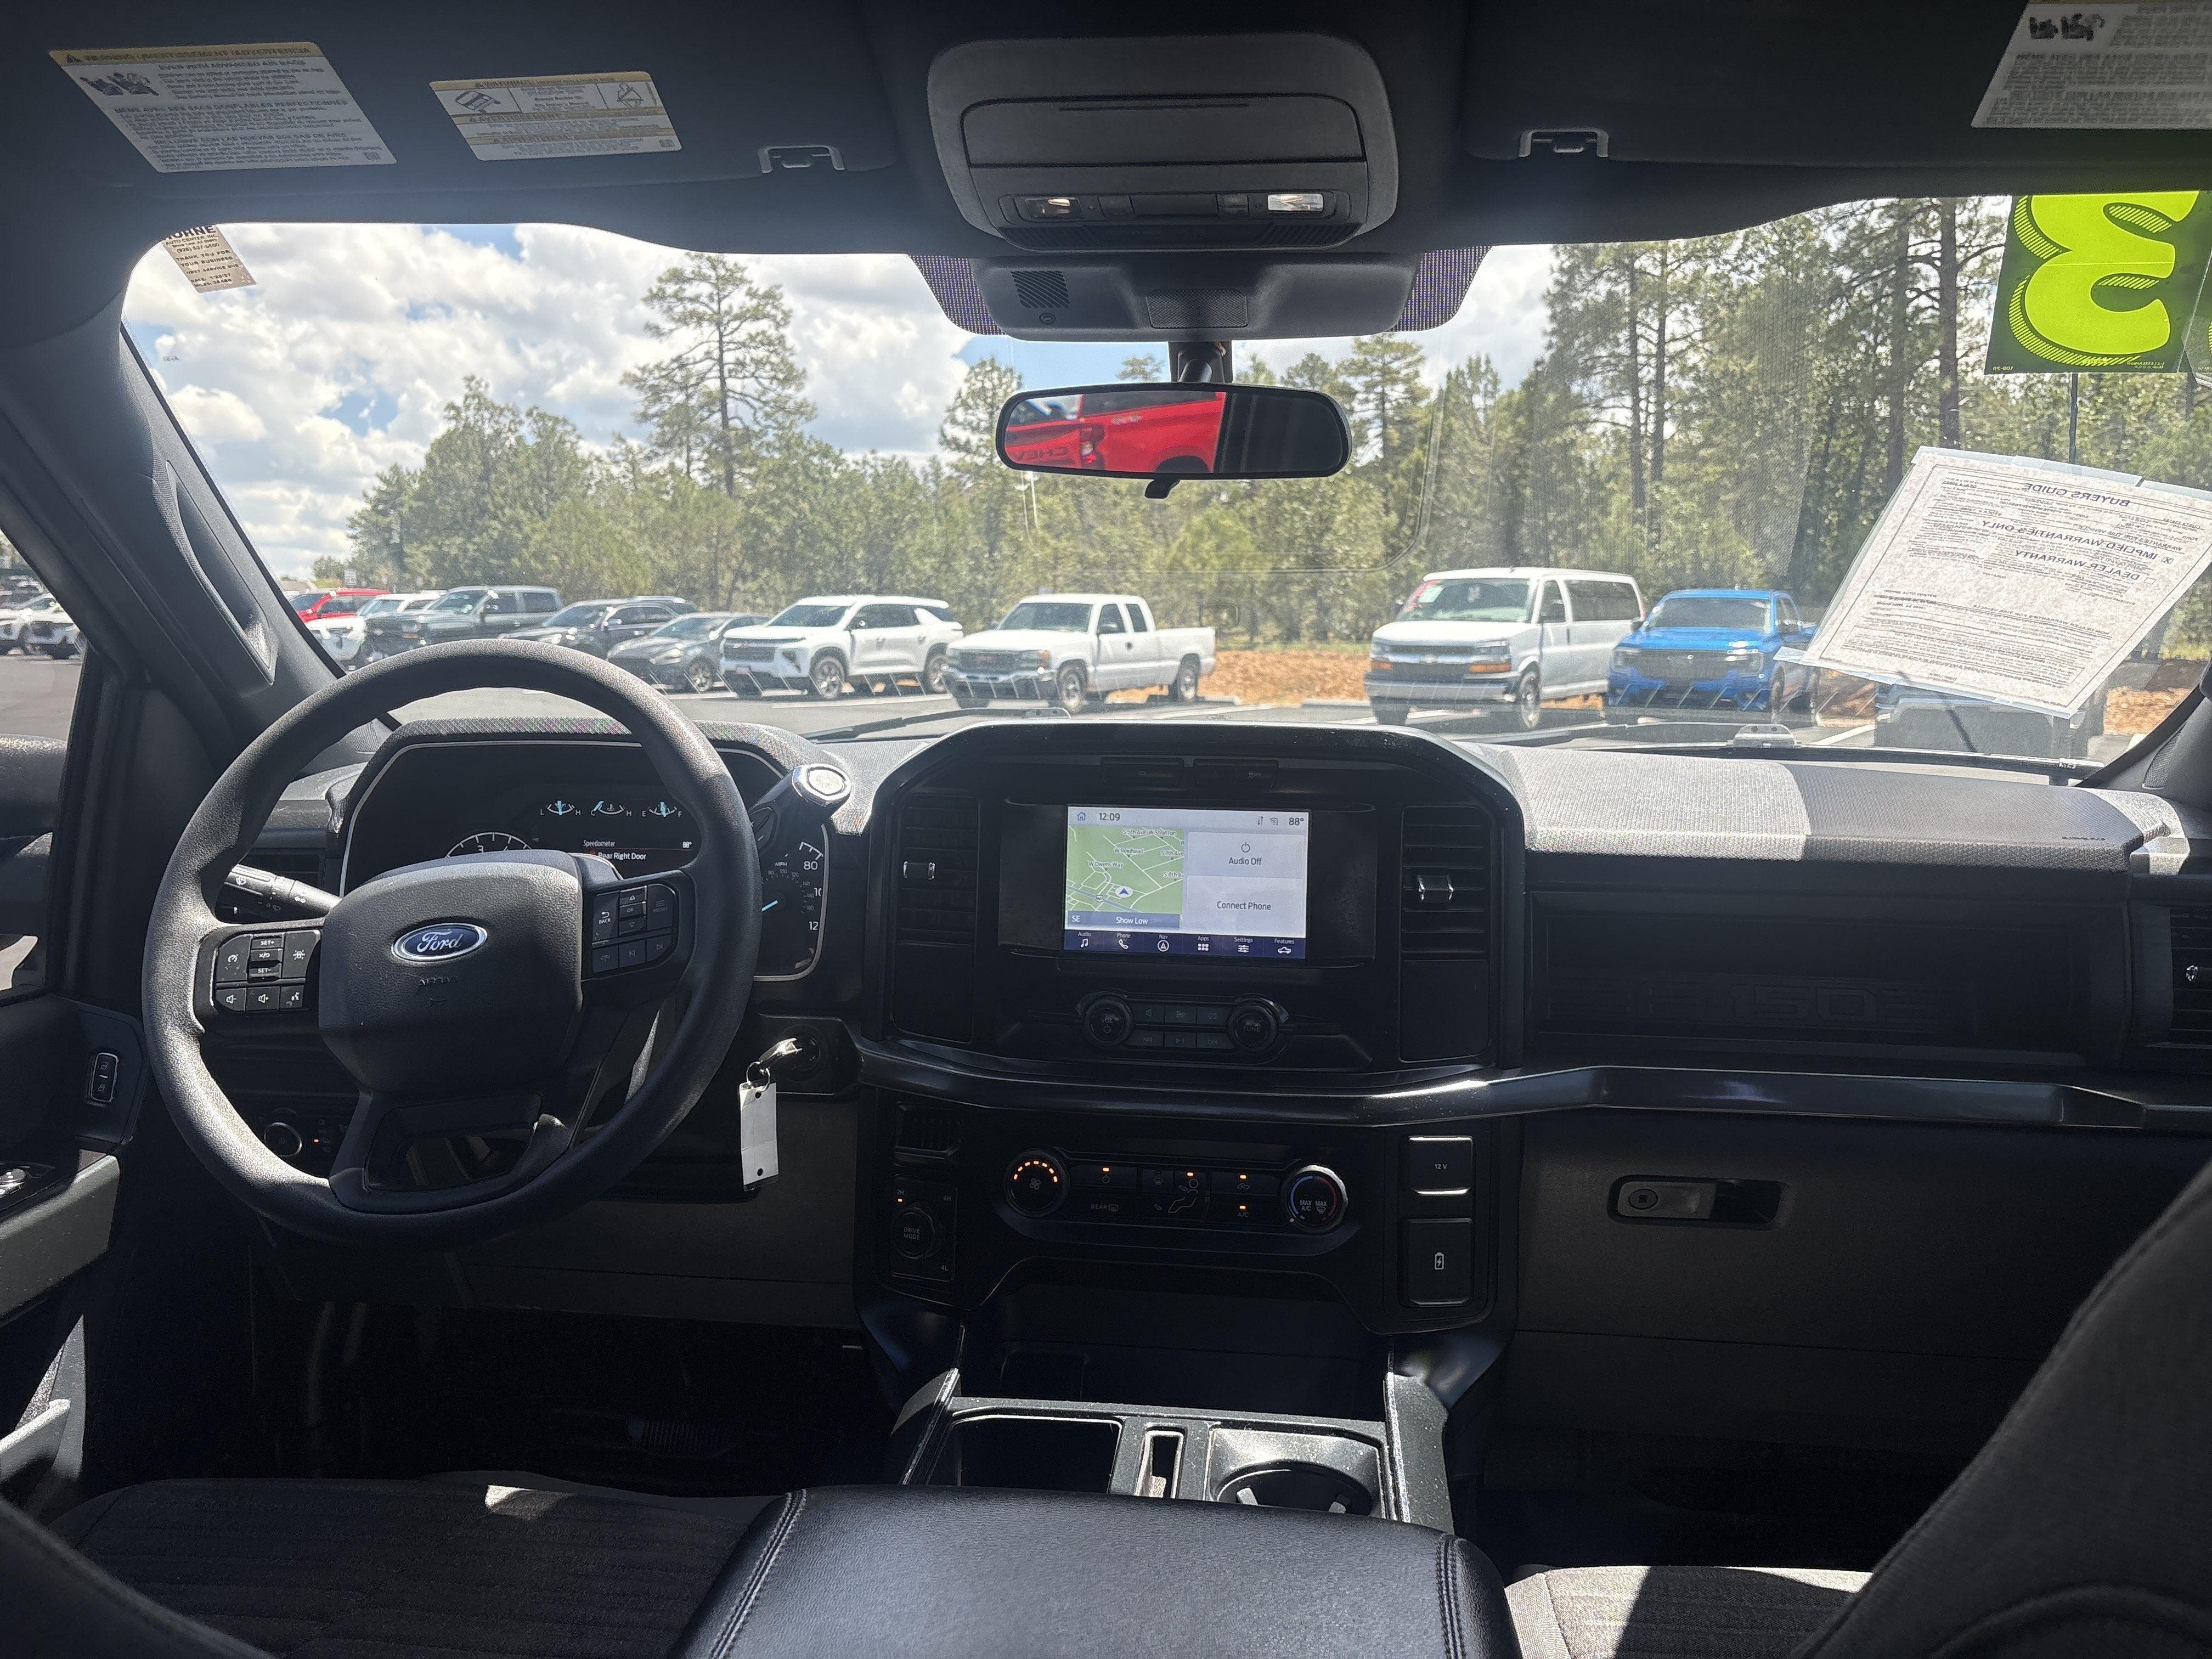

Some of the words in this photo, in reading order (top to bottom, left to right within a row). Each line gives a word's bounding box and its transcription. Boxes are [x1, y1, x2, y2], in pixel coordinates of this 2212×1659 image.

[165, 225, 217, 240] ORNE
[1099, 812, 1120, 822] 12:09
[1288, 817, 1304, 826] 88°
[803, 861, 818, 870] 80
[1229, 857, 1249, 866] Audio
[1250, 857, 1262, 866] Off
[1217, 901, 1246, 910] Connect
[1248, 902, 1272, 911] Phone
[416, 930, 462, 953] Ford
